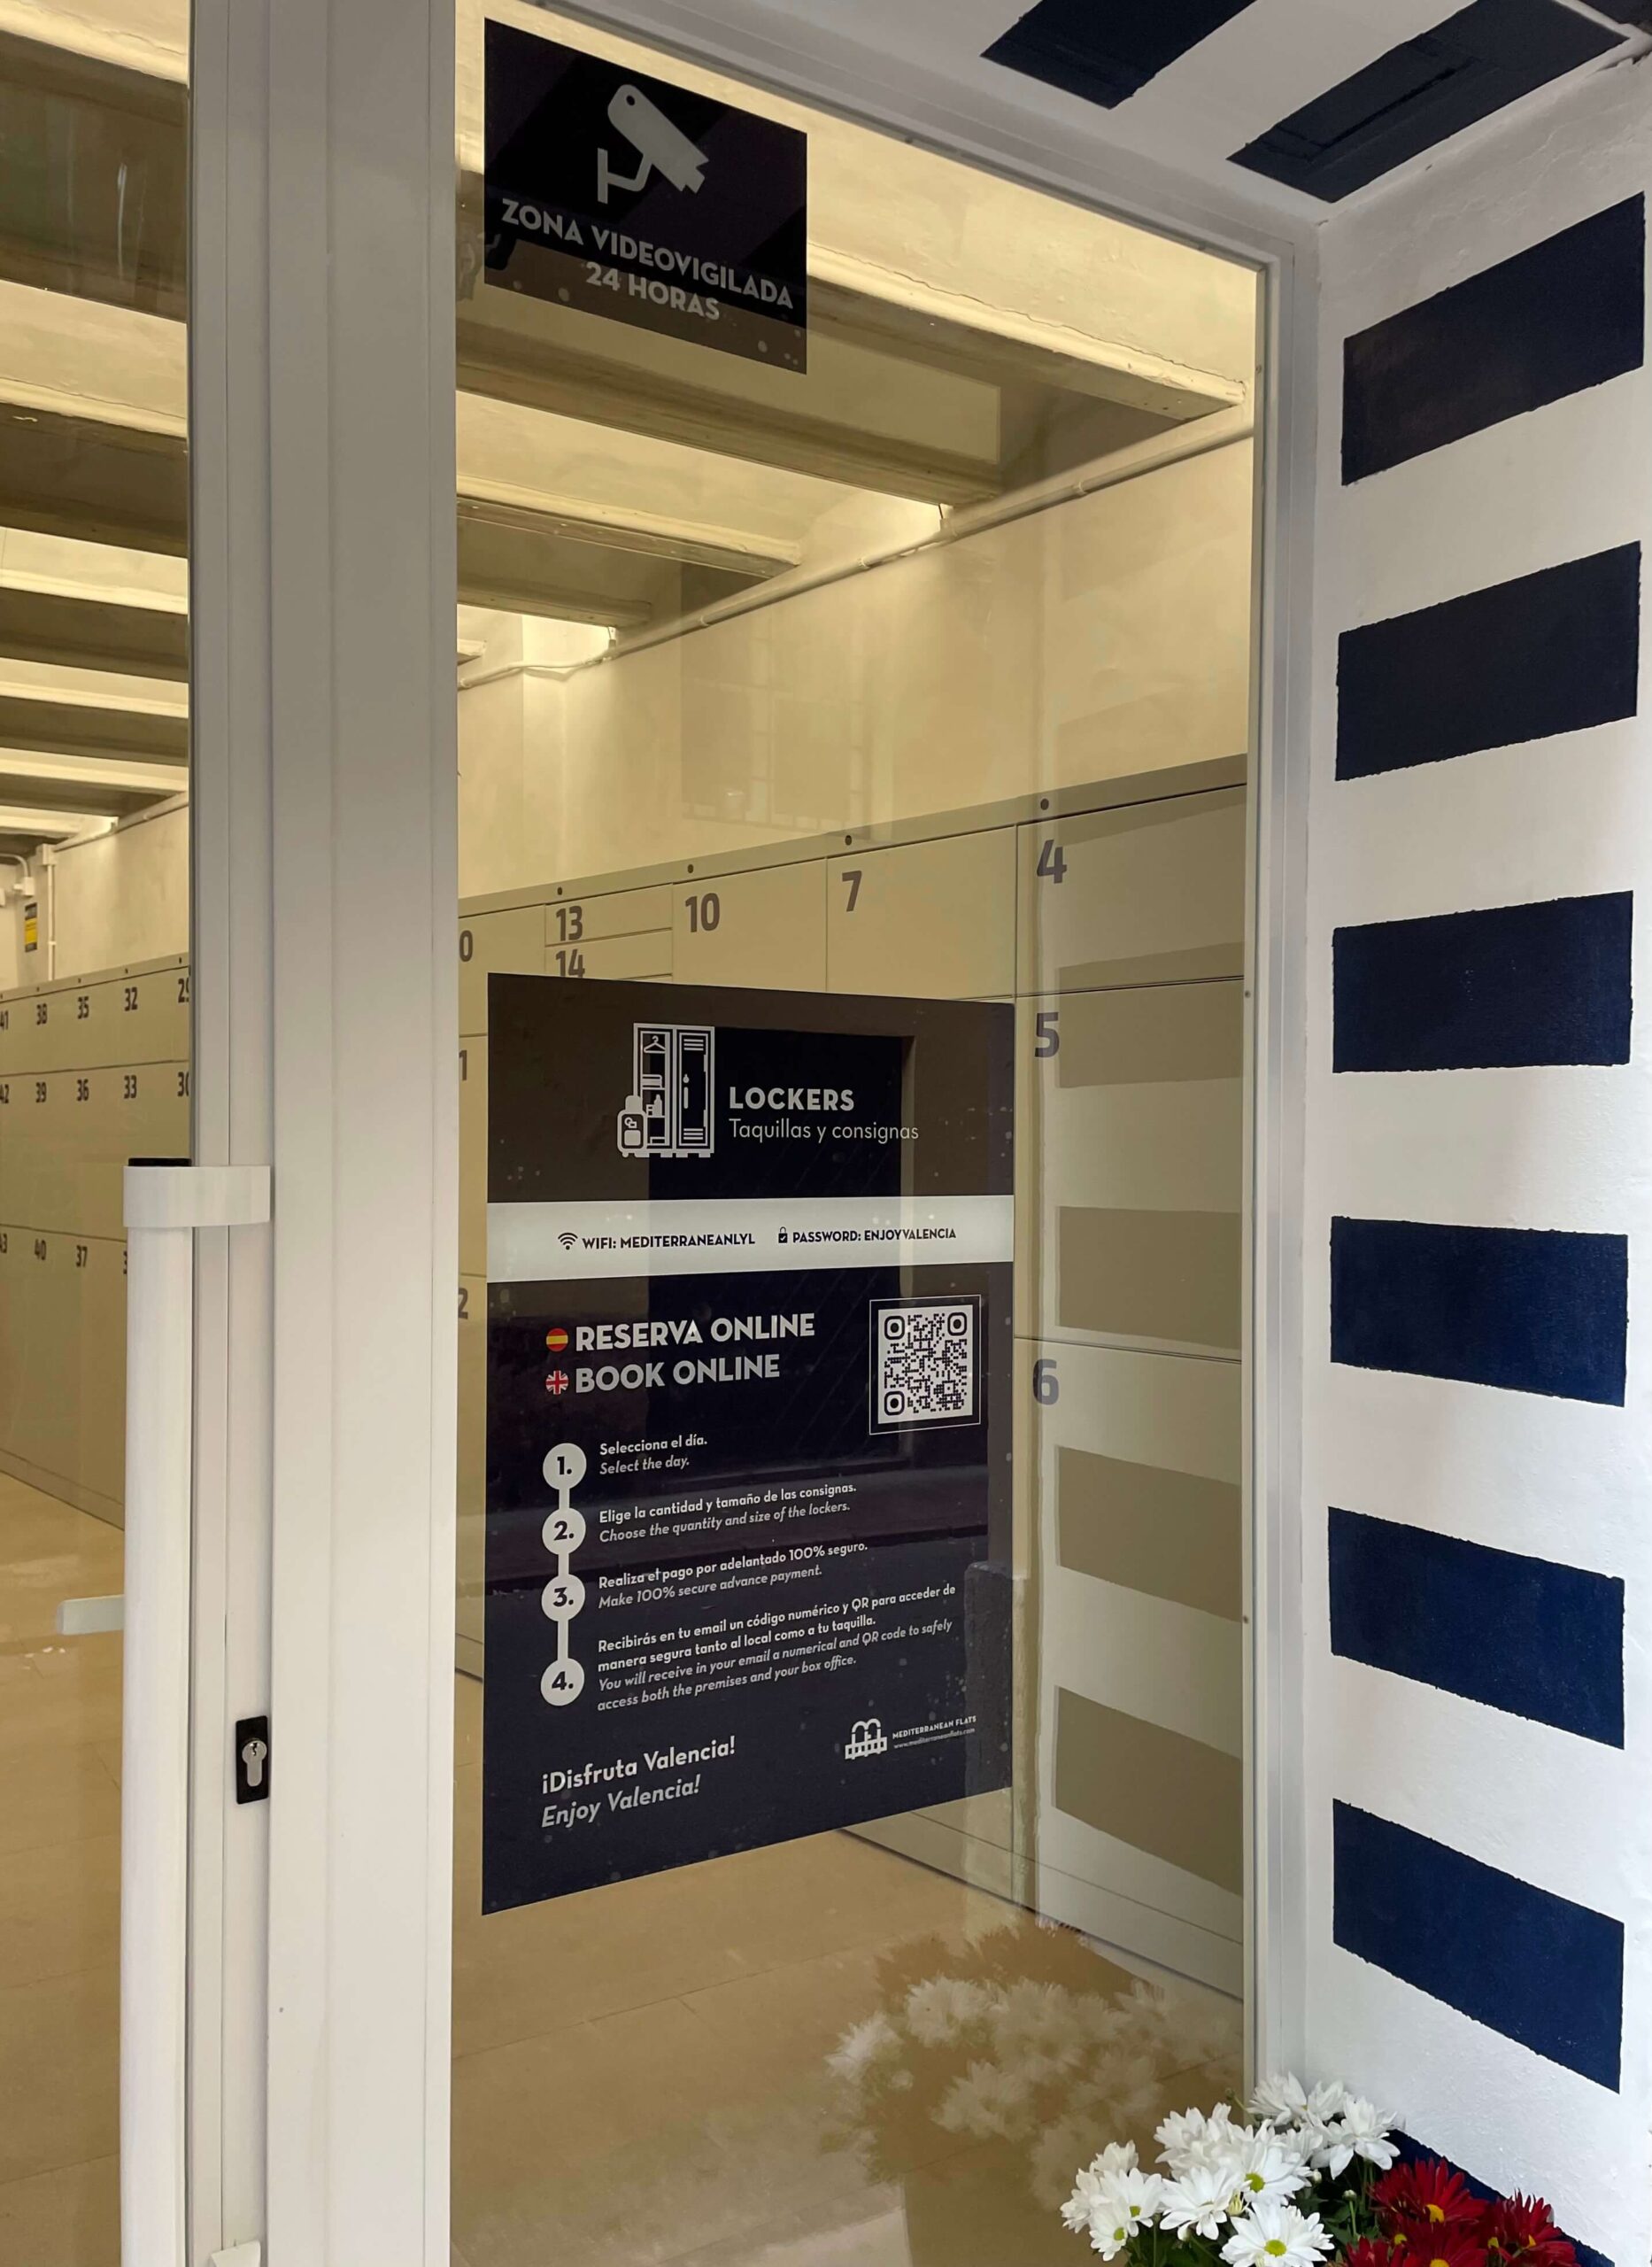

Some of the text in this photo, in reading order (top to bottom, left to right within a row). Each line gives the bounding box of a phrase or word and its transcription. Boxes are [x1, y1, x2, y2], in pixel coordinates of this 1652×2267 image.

[502, 198, 793, 309] ZONA VIDEOVIGILADA
[586, 261, 720, 321] 24 HORAS
[1037, 839, 1067, 884] 4
[842, 870, 862, 912] 7
[556, 906, 583, 941] 13
[684, 892, 721, 932] 10
[459, 931, 474, 962] 0
[555, 949, 585, 978] 14
[78, 996, 89, 1019] 35
[125, 986, 137, 1011] 32
[1034, 1011, 1060, 1057] 5
[459, 1050, 467, 1080] 1
[77, 1079, 89, 1101] 36
[124, 1075, 137, 1099] 33
[730, 1087, 854, 1111] LOCKERS
[729, 1118, 919, 1143] Taquillas y consignas
[583, 1234, 755, 1250] WIFI: MEDITERRANEANLYL
[792, 1228, 956, 1243] PASSWORD: ENJOYVALENCIA
[76, 1245, 88, 1267] 37
[459, 1288, 468, 1319] 2
[575, 1312, 815, 1351] RESERVA ONLINE
[575, 1354, 780, 1394] BOOK ONLINE
[1033, 1358, 1060, 1405] 6
[600, 1435, 707, 1455] Selecciona el día.
[557, 1457, 572, 1474] 1.
[599, 1455, 690, 1474] Select the day.
[600, 1483, 856, 1525] Elige la cantidad y tamaño de las consignas.
[554, 1520, 574, 1541] 2.
[599, 1501, 850, 1543] Choose the quantity and size of the lockers.
[599, 1542, 868, 1589] Realiza el pago por adelantado 100% seguro.
[553, 1587, 574, 1606] 3.
[598, 1566, 822, 1609] Make 100% secure advance payment.
[598, 1583, 955, 1652] Recibirás en tu email un código numérico y QR para acceder de
[598, 1656, 646, 1672] manera
[650, 1647, 691, 1663] segura
[695, 1642, 727, 1655] tanto
[730, 1636, 741, 1649] al
[745, 1631, 771, 1646] local
[775, 1629, 805, 1642] como
[818, 1623, 829, 1633] tu
[832, 1615, 876, 1631] taquilla.
[599, 1677, 621, 1691] You
[625, 1671, 646, 1686] will
[648, 1667, 692, 1683] receive
[696, 1661, 706, 1673] in
[709, 1659, 736, 1674] your
[738, 1649, 770, 1666] email
[783, 1638, 838, 1659] numerical
[839, 1634, 860, 1648] and
[862, 1631, 878, 1646] QR
[881, 1626, 906, 1641] code
[908, 1625, 919, 1636] to
[922, 1619, 953, 1635] safely
[552, 1671, 574, 1691] 4.
[598, 1655, 857, 1711] access both the premises and your box office.
[892, 1715, 977, 1739] MEDITERRANEAN FLATS
[543, 1736, 735, 1794] ¡Disfruta Valencia!
[542, 1774, 700, 1828] Enjoy Valencia!
